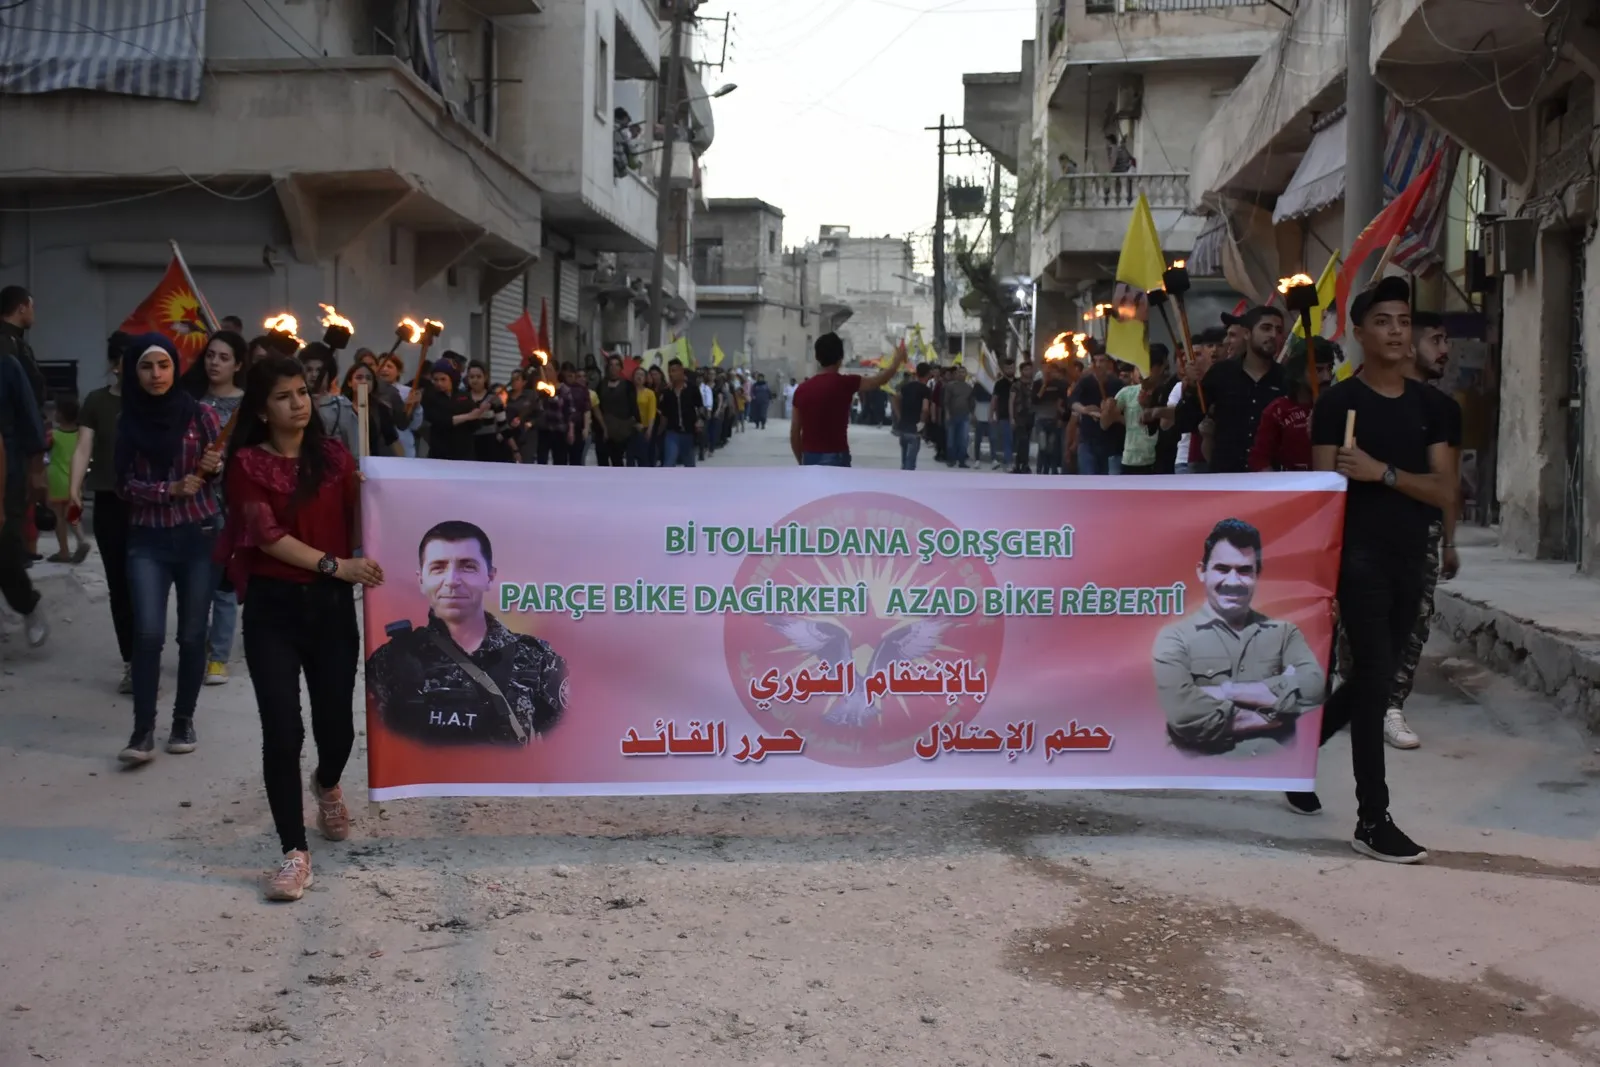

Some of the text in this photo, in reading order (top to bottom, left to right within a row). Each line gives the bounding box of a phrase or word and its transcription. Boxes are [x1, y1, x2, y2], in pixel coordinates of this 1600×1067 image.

[703, 523, 910, 556] TOLHÎLDANA
[918, 526, 1073, 563] ŞORŞGERÎ
[501, 583, 605, 619] PARÇE
[887, 589, 978, 616] AZAD
[1060, 582, 1186, 614] RÊBERTÎ
[750, 660, 988, 709] بالإنتقام الثوري
[428, 710, 478, 729] H.A.T
[621, 718, 725, 757] القائد
[733, 726, 805, 763] حرر
[916, 721, 1034, 763] الإحتلال
[1045, 721, 1114, 763] حطم
